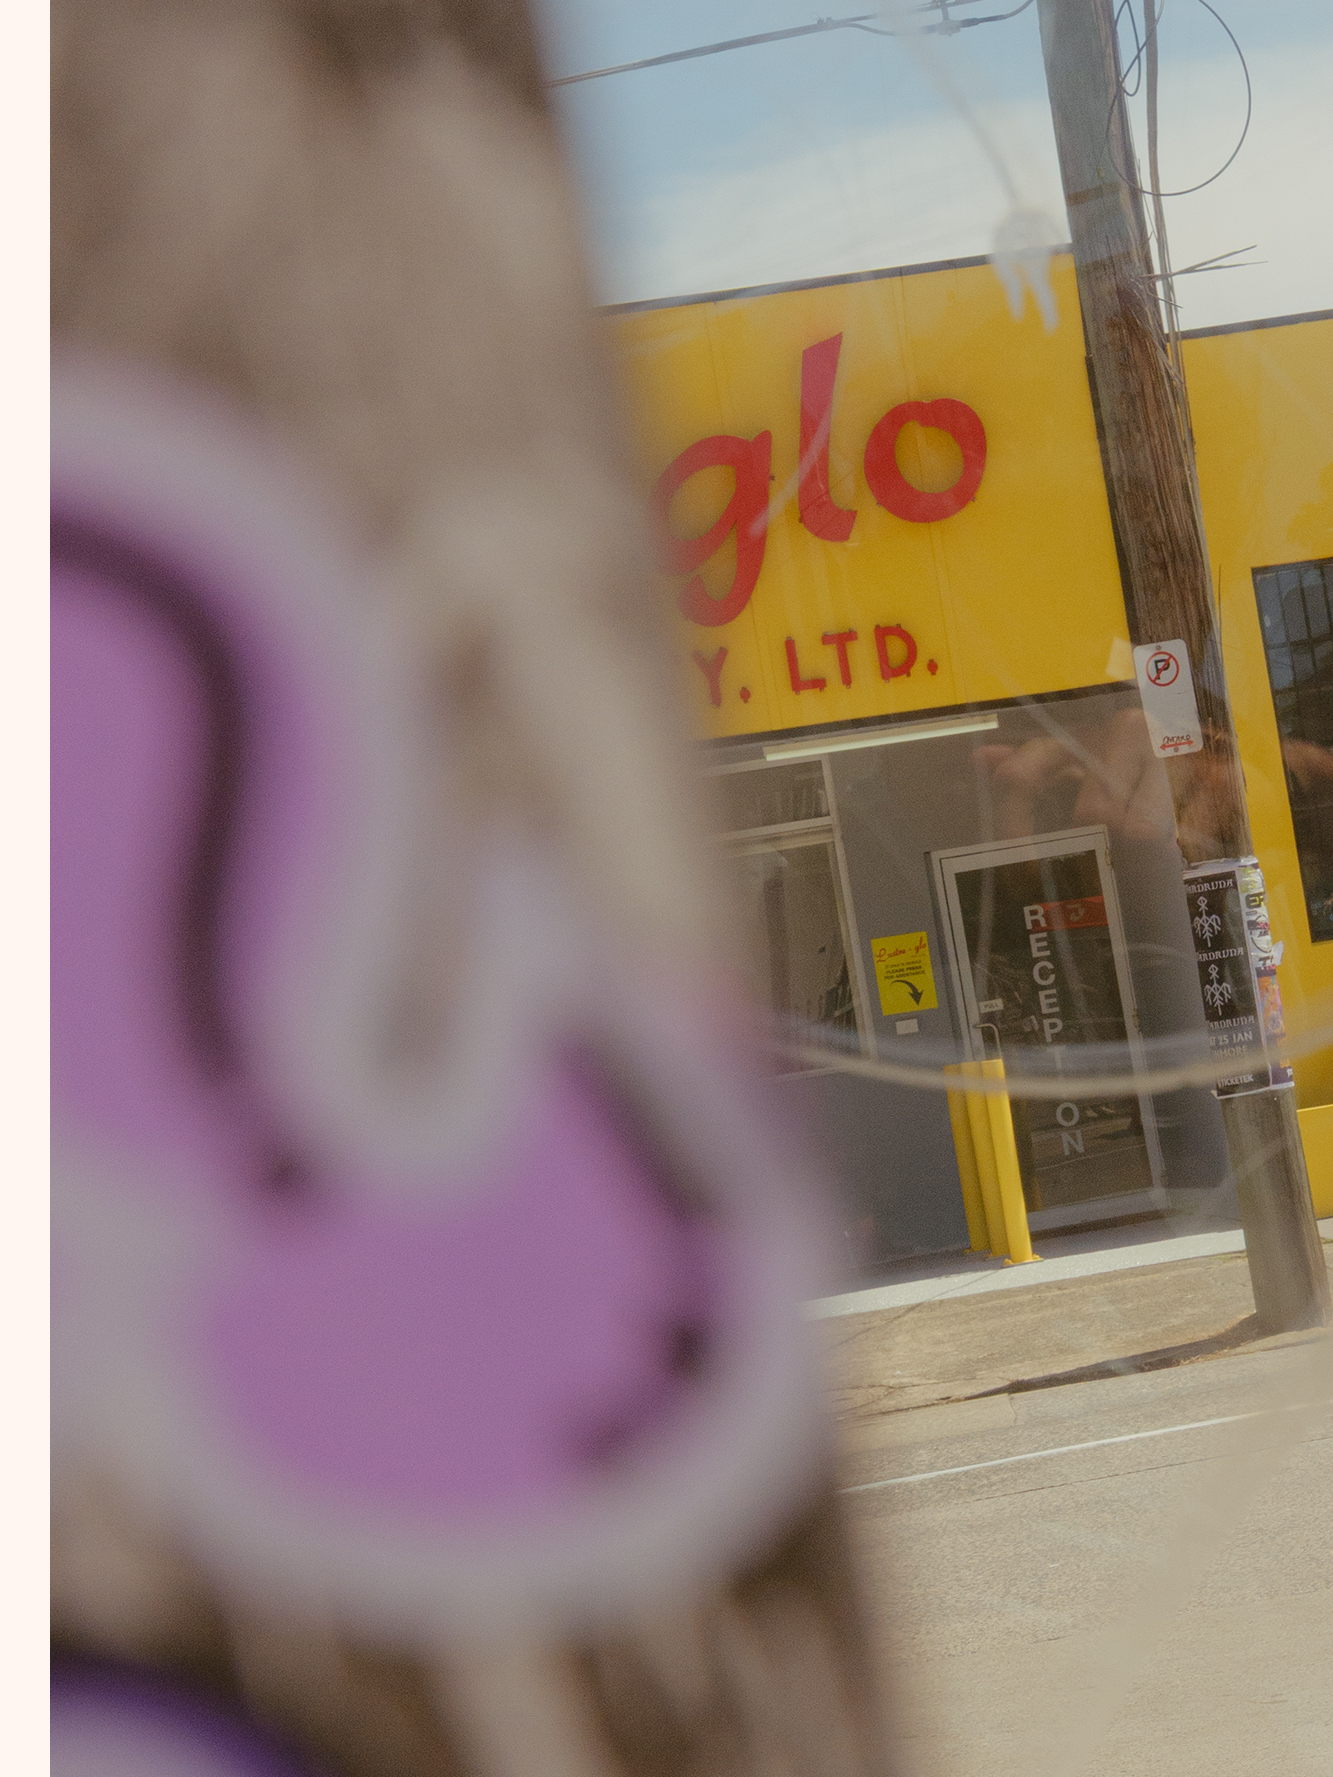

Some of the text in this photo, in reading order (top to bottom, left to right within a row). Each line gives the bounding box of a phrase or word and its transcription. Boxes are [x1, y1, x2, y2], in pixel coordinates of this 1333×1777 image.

[650, 331, 988, 629] glo
[691, 624, 938, 708] Y. LTD.
[1023, 904, 1086, 1157] RECEPTON
